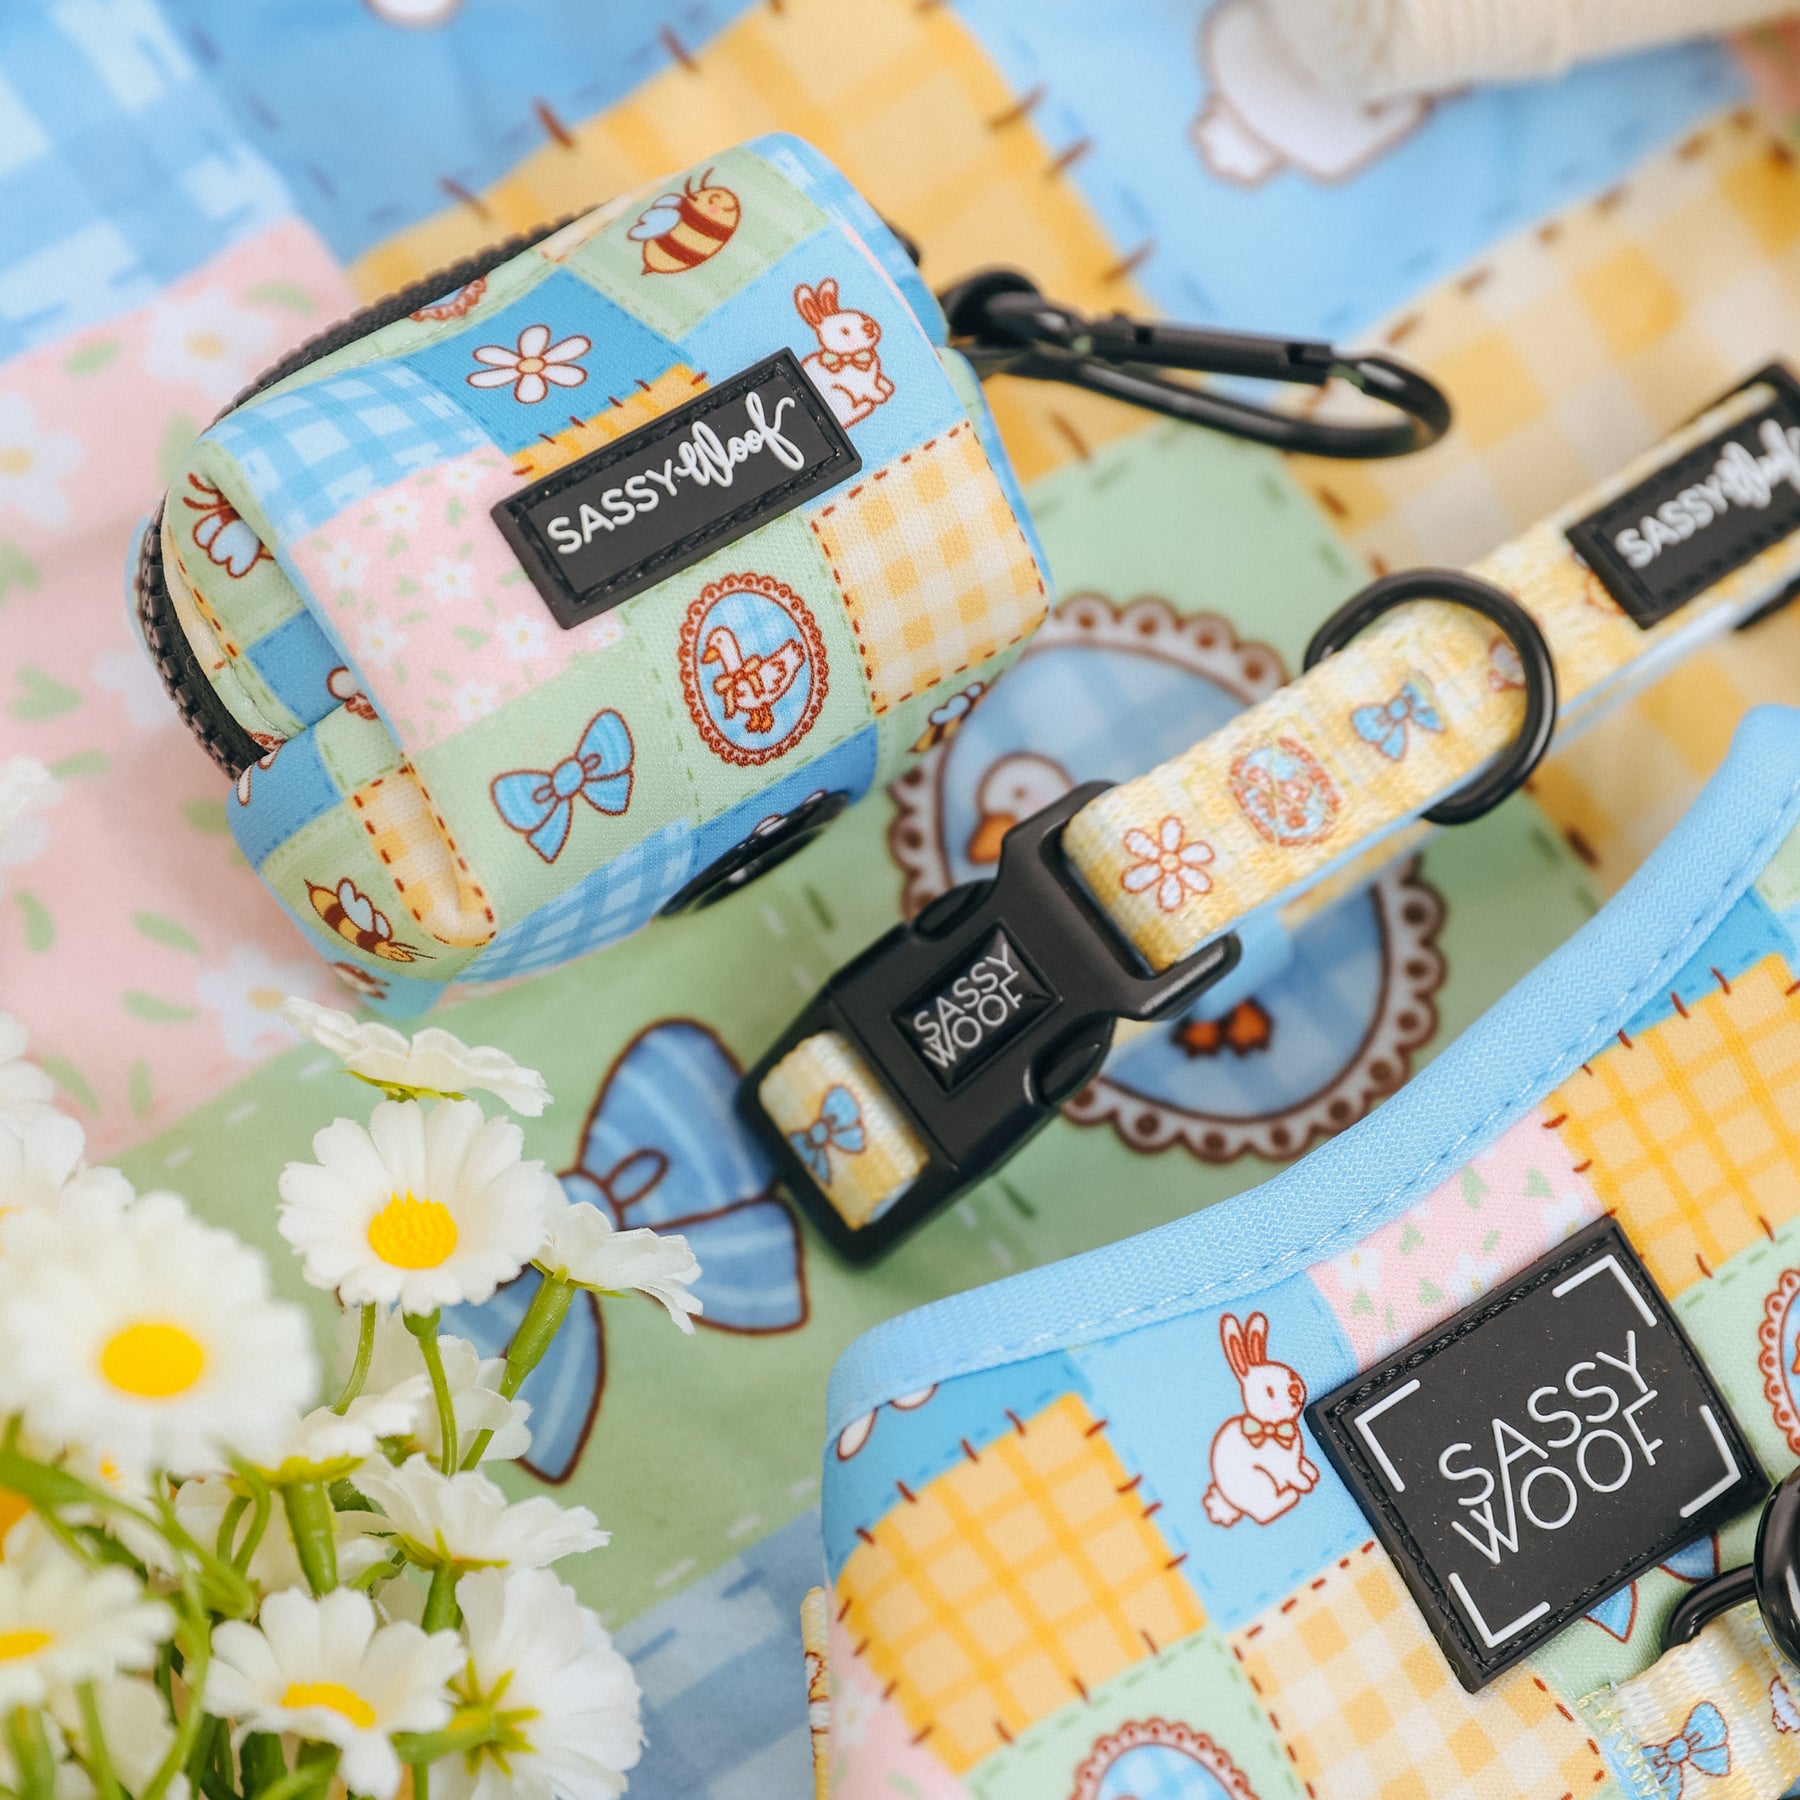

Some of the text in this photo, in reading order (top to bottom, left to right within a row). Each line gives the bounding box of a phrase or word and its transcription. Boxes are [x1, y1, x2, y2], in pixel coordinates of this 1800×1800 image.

[547, 391, 805, 554] SASSY Woof
[1614, 474, 1729, 568] SASSY
[913, 943, 1014, 1044] SASSY
[923, 970, 1023, 1069] WOOF
[1438, 1330, 1649, 1506] SASSY
[1450, 1390, 1664, 1565] WOOF
